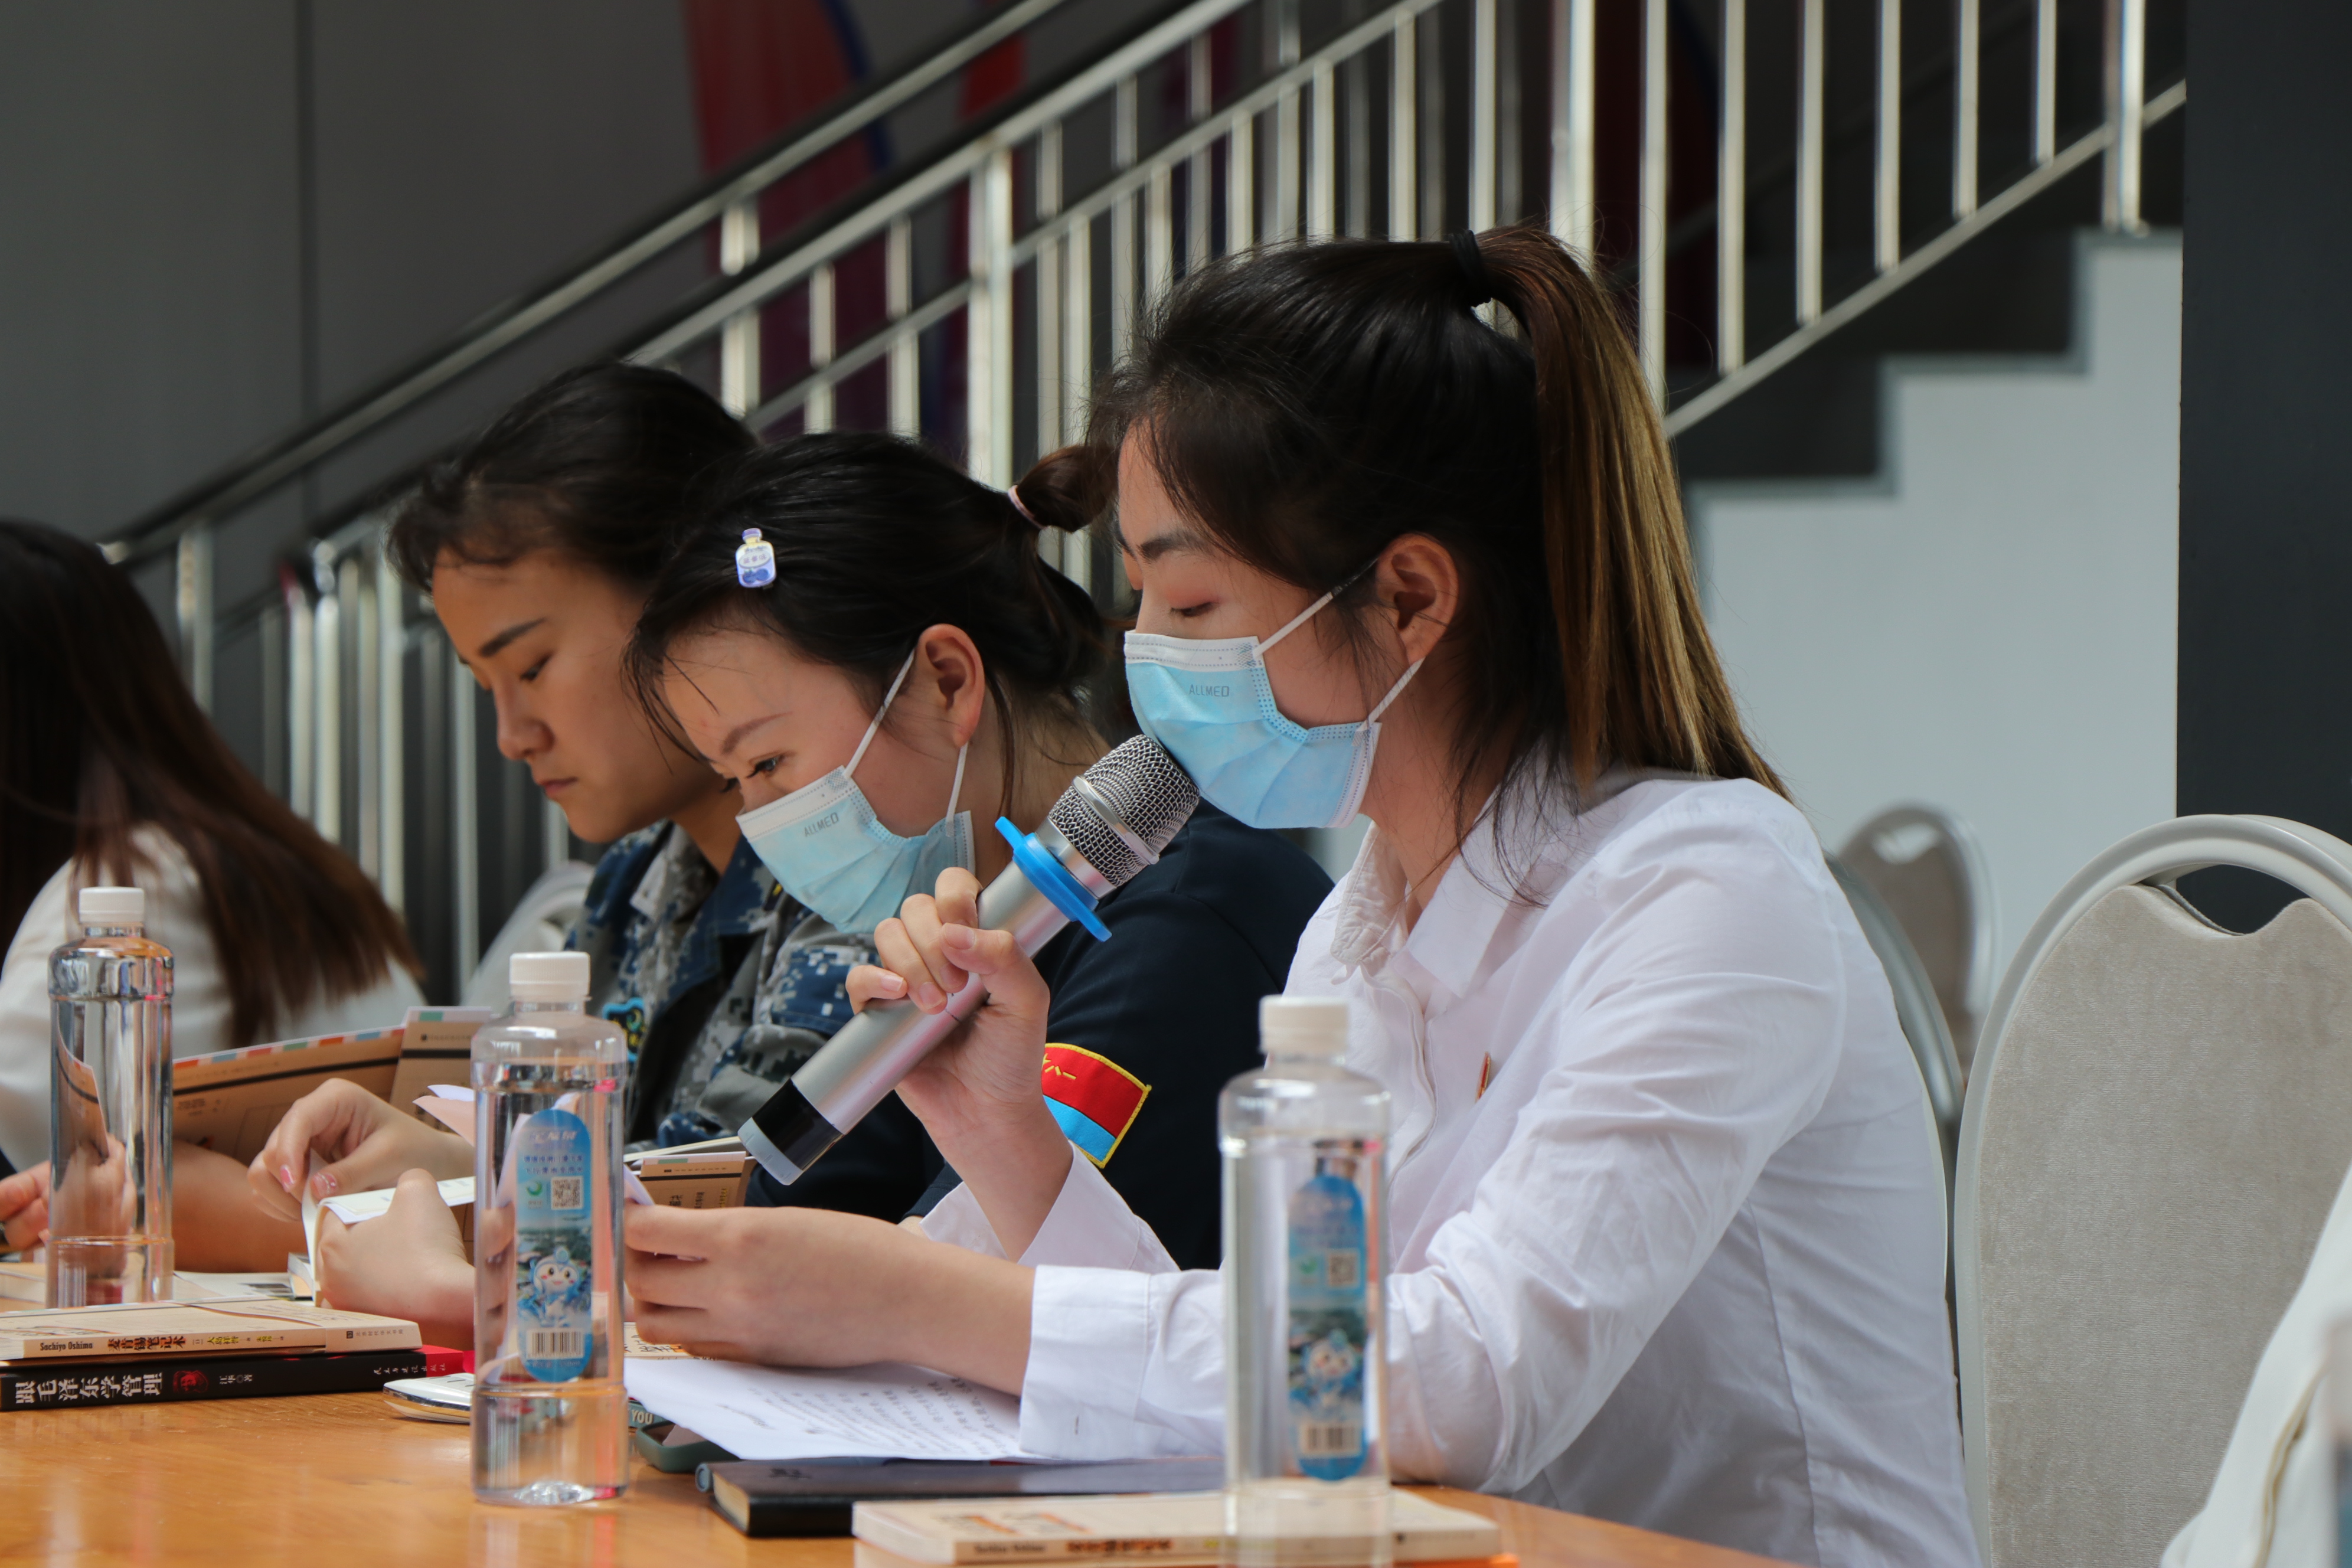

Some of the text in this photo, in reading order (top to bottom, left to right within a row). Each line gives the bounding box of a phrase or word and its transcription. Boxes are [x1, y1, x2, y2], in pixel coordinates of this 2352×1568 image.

[1188, 684, 1230, 697] ALLMED
[803, 812, 839, 837] ALLMED
[40, 1341, 93, 1351] Sachiyo Oshima
[374, 1363, 446, 1375] 民主与建设出版社
[15, 1372, 164, 1404] 跟毛泽东学管理
[631, 1409, 654, 1425] YOU
